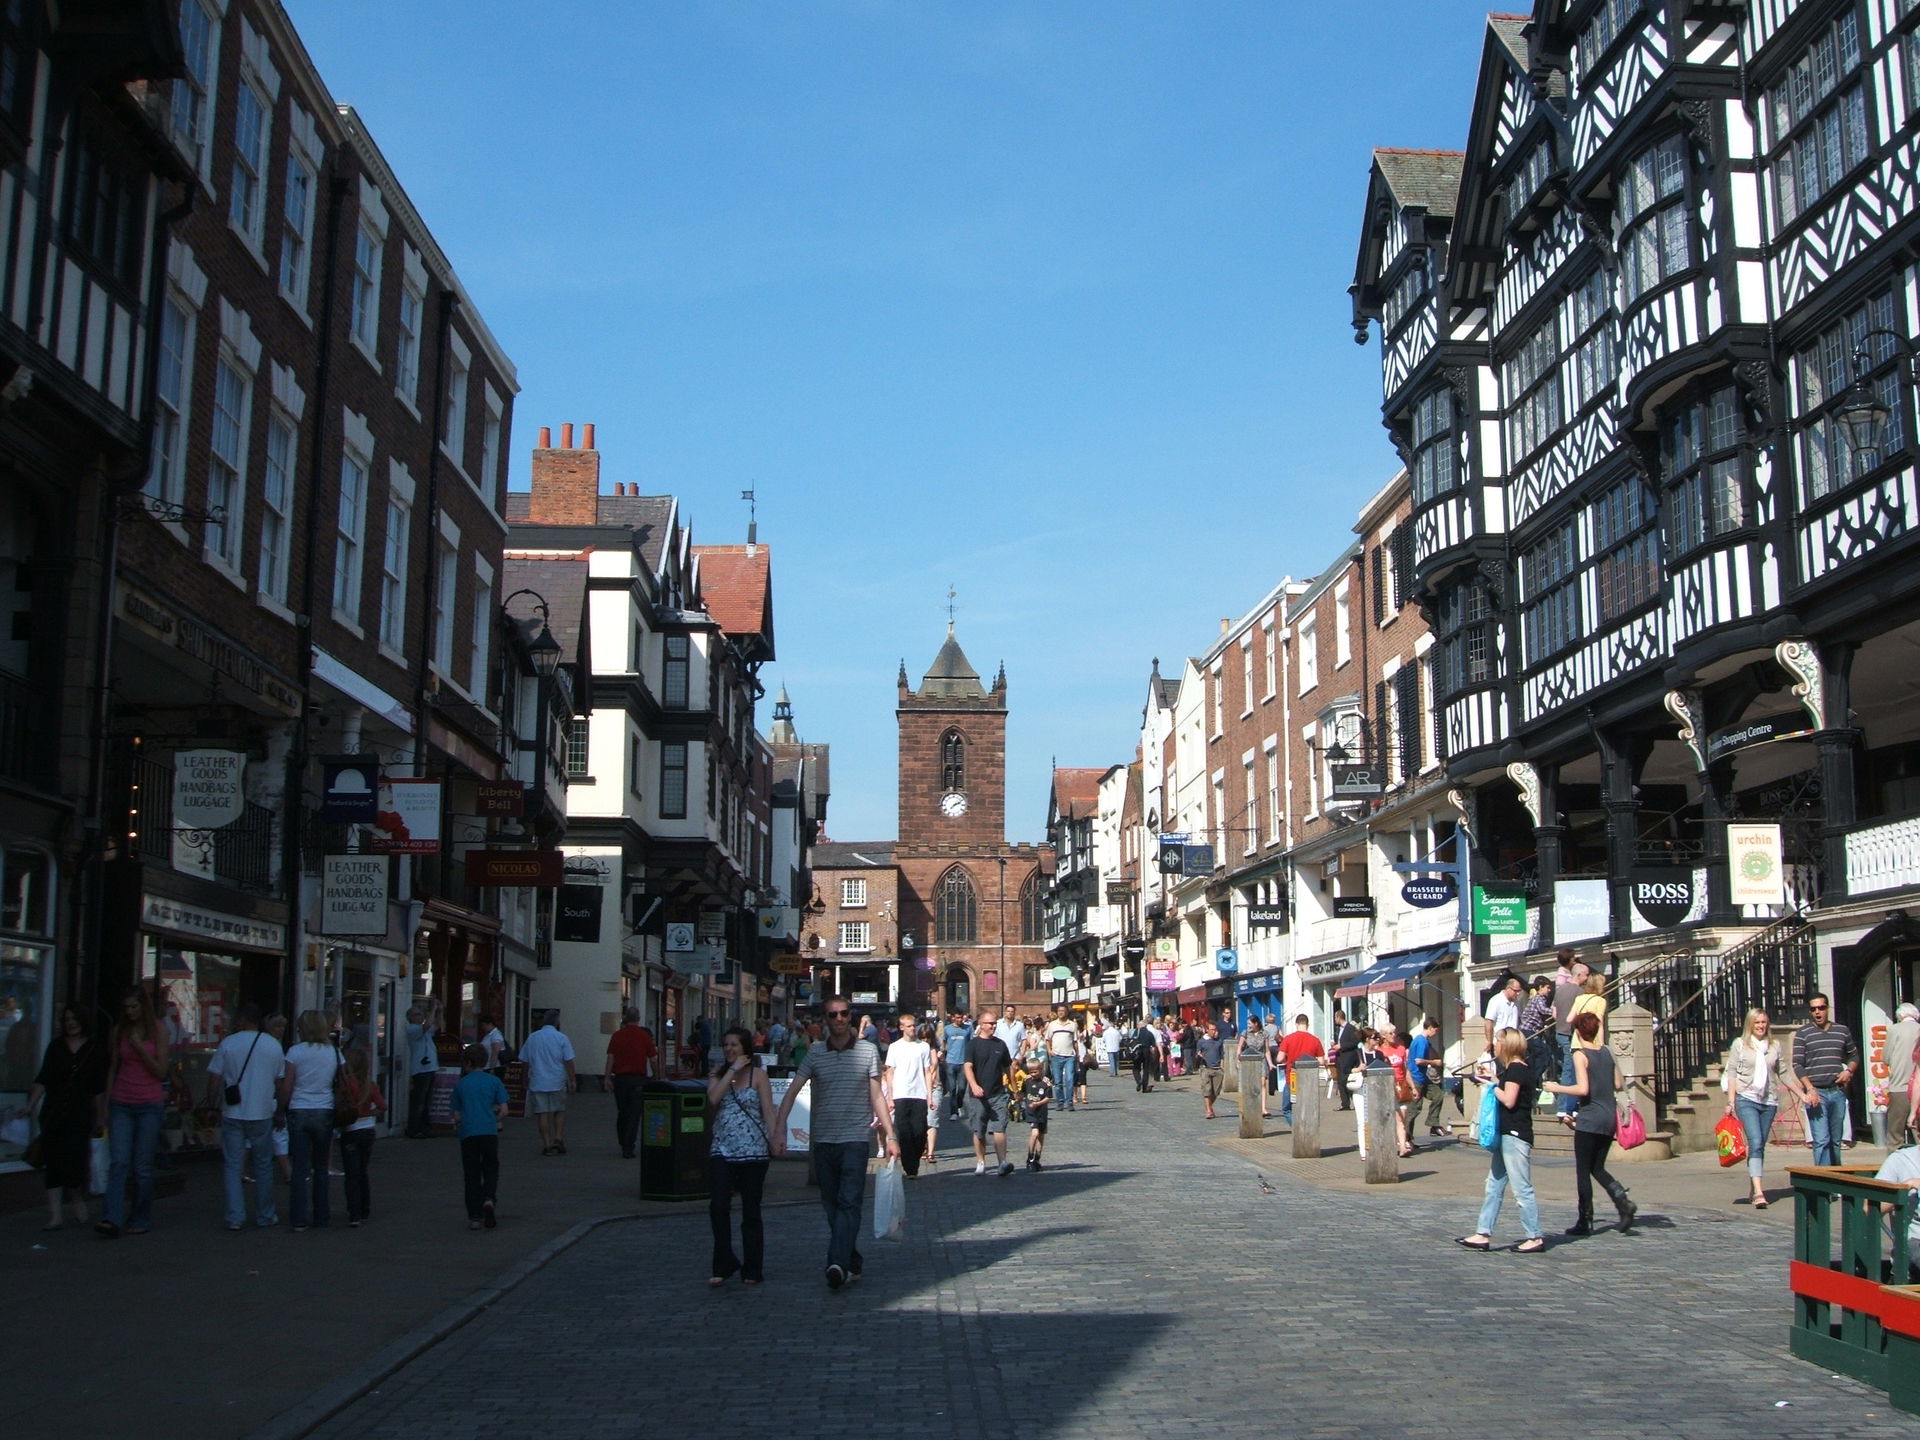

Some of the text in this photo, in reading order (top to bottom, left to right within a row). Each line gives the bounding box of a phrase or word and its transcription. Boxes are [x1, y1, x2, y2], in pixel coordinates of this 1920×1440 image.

[1722, 730, 1747, 746] Shopping
[1748, 724, 1773, 737] Centre
[183, 756, 237, 769] LEATHER
[191, 768, 228, 780] GOODS
[1344, 771, 1370, 785] AR
[180, 782, 237, 793] HANDBAGS
[479, 787, 521, 800] Liberty
[183, 796, 231, 808] LUGGAGE
[488, 800, 512, 810] Bell
[1737, 833, 1772, 845] urchin
[328, 861, 382, 873] LEATHER
[489, 864, 538, 874] NICOLAS
[335, 873, 375, 885] GOODS
[326, 887, 384, 899] HANDBAGS
[1637, 882, 1689, 899] BOSS
[1481, 894, 1520, 905] Eduardo
[331, 901, 377, 913] LUGGAGE
[564, 906, 591, 918] South
[1489, 905, 1513, 917] Pelle
[1250, 910, 1281, 921] lakeland
[150, 903, 279, 942] SHUTTLEWORTH'S
